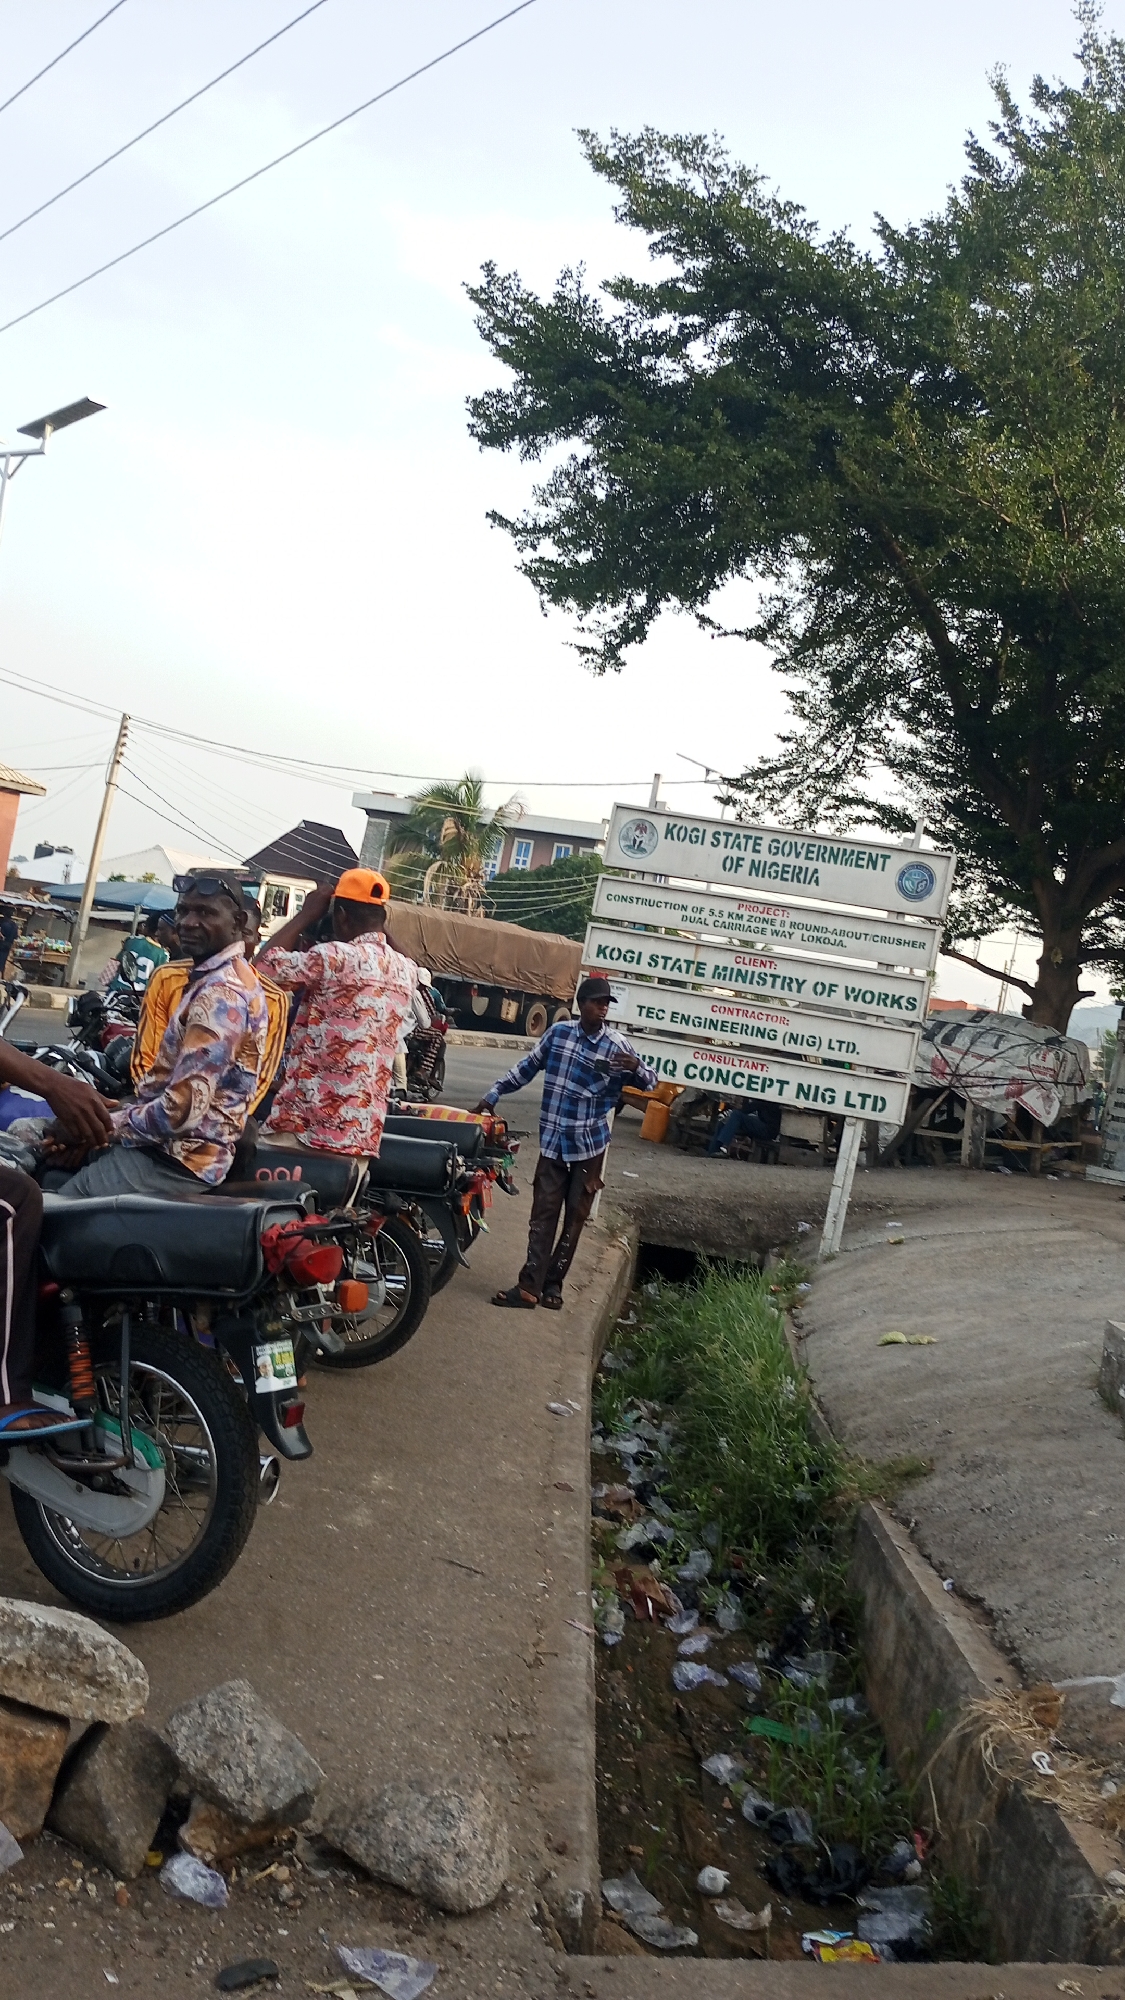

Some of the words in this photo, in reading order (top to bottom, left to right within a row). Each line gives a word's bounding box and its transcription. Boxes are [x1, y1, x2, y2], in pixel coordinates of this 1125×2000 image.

[664, 822, 706, 845] KOGI
[711, 831, 763, 853] STATE
[768, 838, 891, 872] GOVERNMENT
[722, 855, 745, 873] OF
[749, 858, 820, 886] NIGERIA
[606, 893, 688, 912] CONSTRUCTION
[691, 906, 705, 915] OF
[708, 908, 724, 918] 5.5
[727, 911, 744, 922] KM
[746, 914, 776, 926] ZONE
[737, 903, 790, 918] PROJECT:
[681, 915, 709, 926] DUAL
[713, 919, 767, 935] CARRIAGE
[770, 929, 795, 940] WAY
[801, 933, 847, 948] LOKOJA.
[596, 944, 642, 965] KOGI
[648, 954, 707, 977] STATE
[711, 965, 807, 994] MINISTRY
[812, 981, 839, 997] OF
[845, 985, 918, 1011] WORKS
[735, 955, 778, 970] CLIENT:
[636, 1004, 665, 1021] TEC
[670, 1011, 778, 1041] ENGINEERING
[782, 1031, 822, 1052] (NIG)
[827, 1038, 860, 1055] LTD.
[711, 1004, 790, 1026] CONTRACTOR:
[693, 1051, 769, 1073] CONSULTANT:
[684, 1063, 790, 1096] CONCEPT
[795, 1082, 836, 1105] NIG
[844, 1090, 887, 1113] LTD
